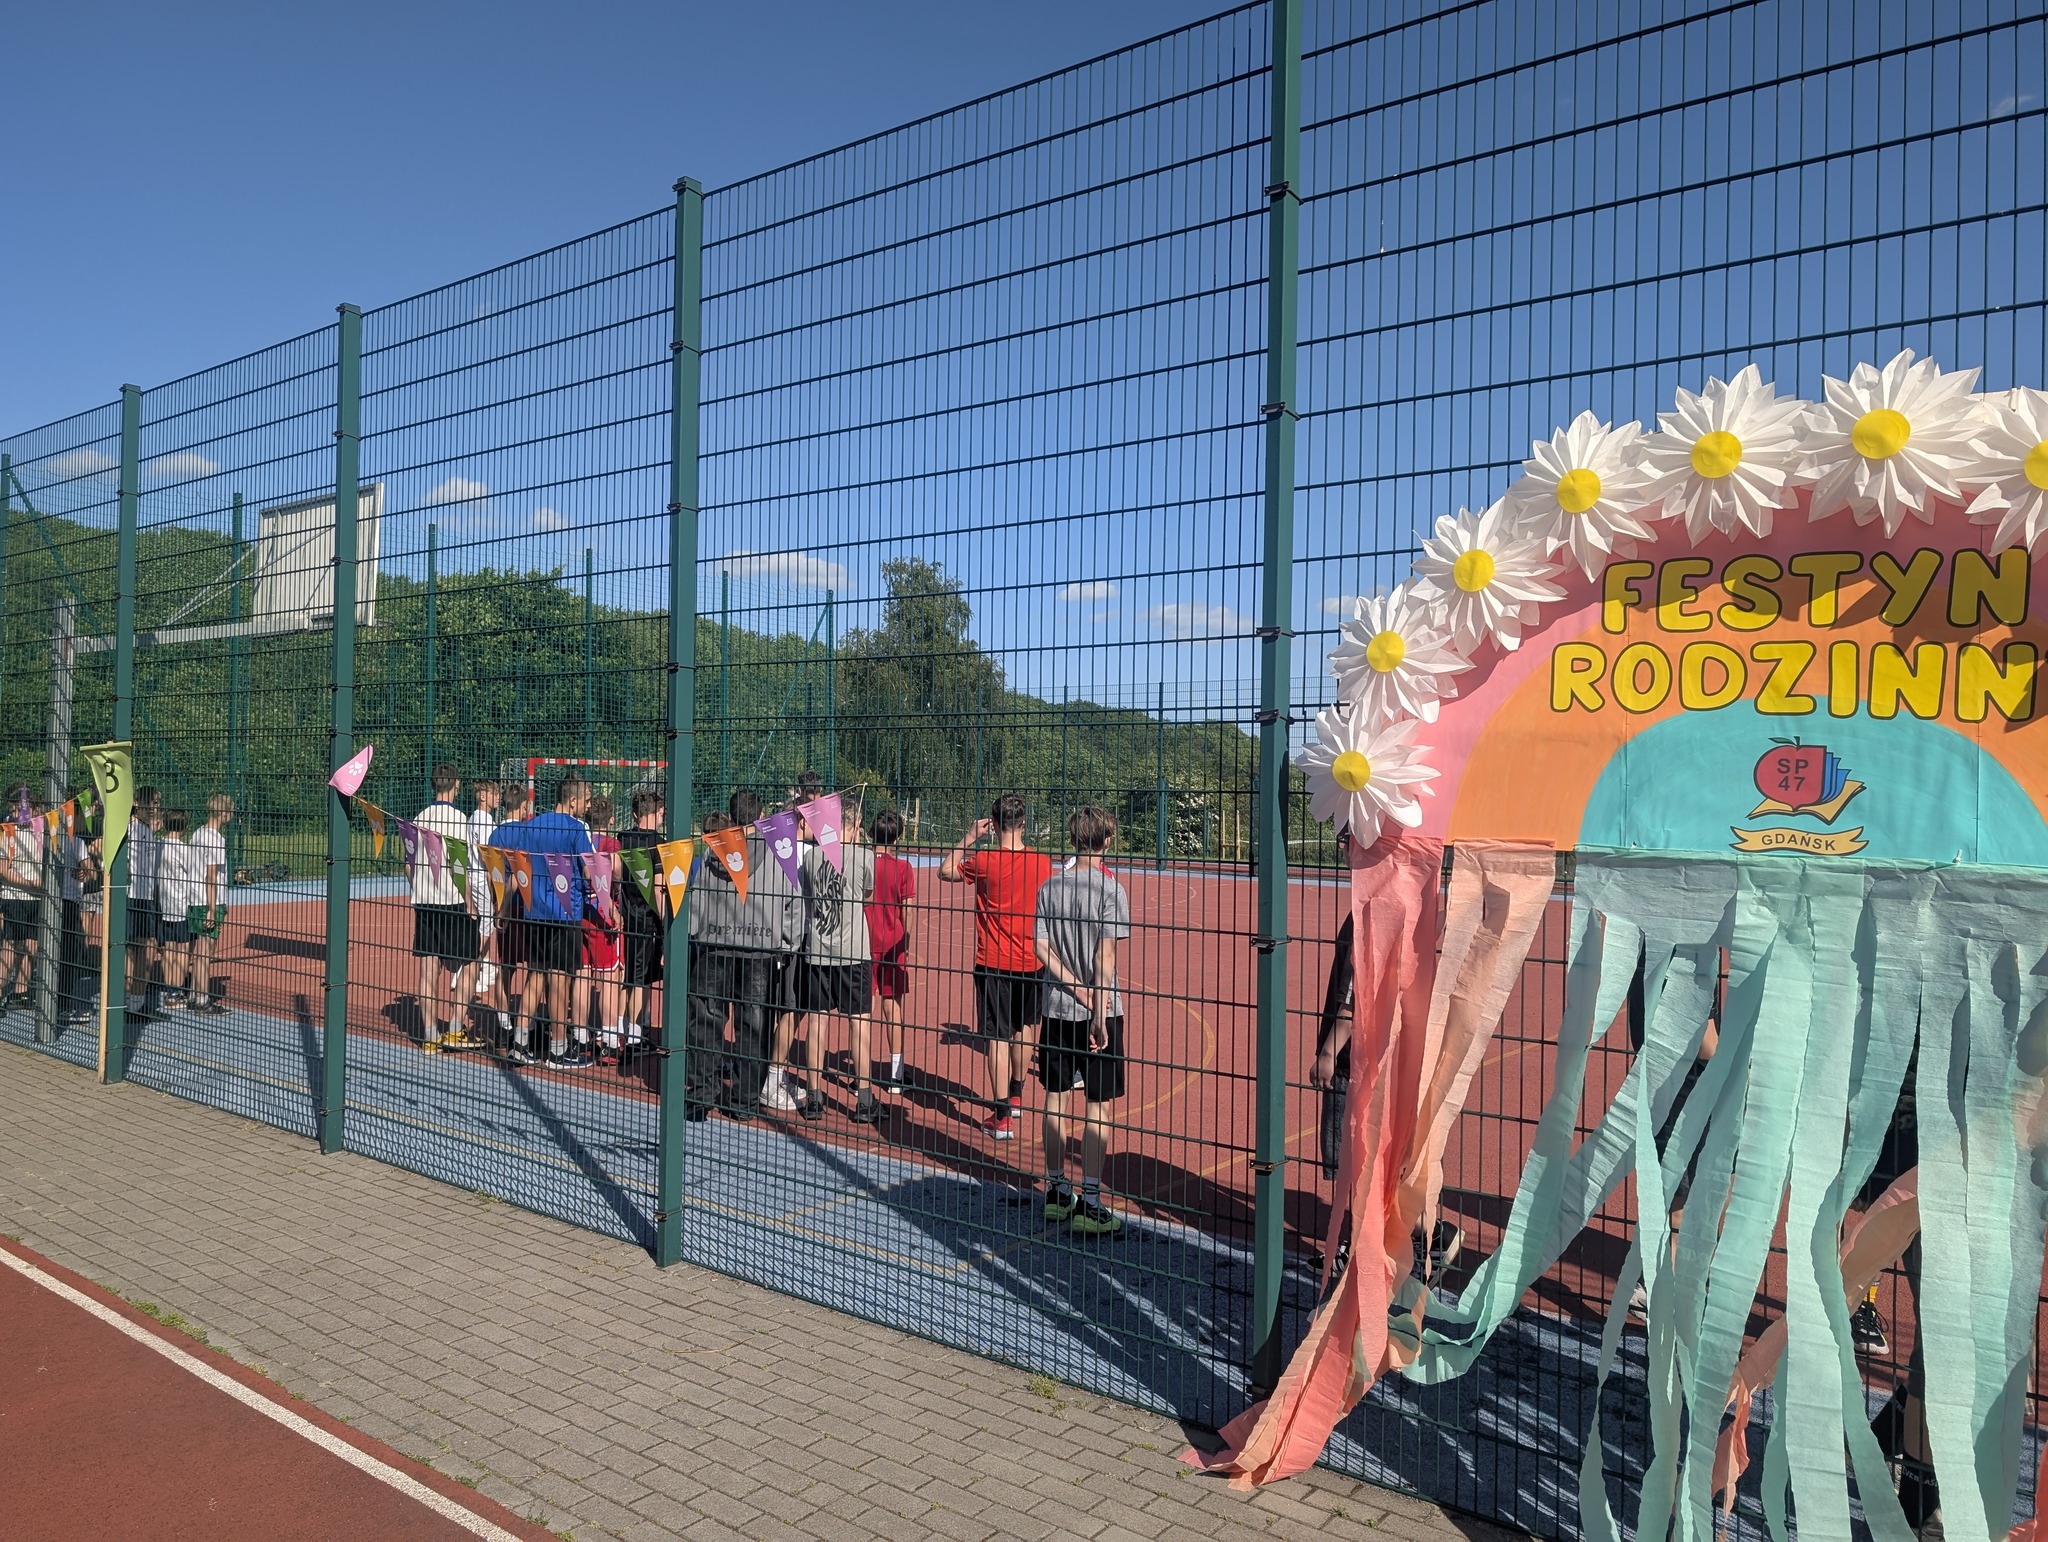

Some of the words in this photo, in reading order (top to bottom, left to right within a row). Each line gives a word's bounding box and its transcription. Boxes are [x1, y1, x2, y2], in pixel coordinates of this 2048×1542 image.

[1601, 545, 2032, 635] FESTYN
[1550, 640, 2048, 722] RODZINN
[1777, 758, 1809, 774] SP
[1778, 776, 1805, 791] 47
[1761, 833, 1836, 851] GDAŃSK
